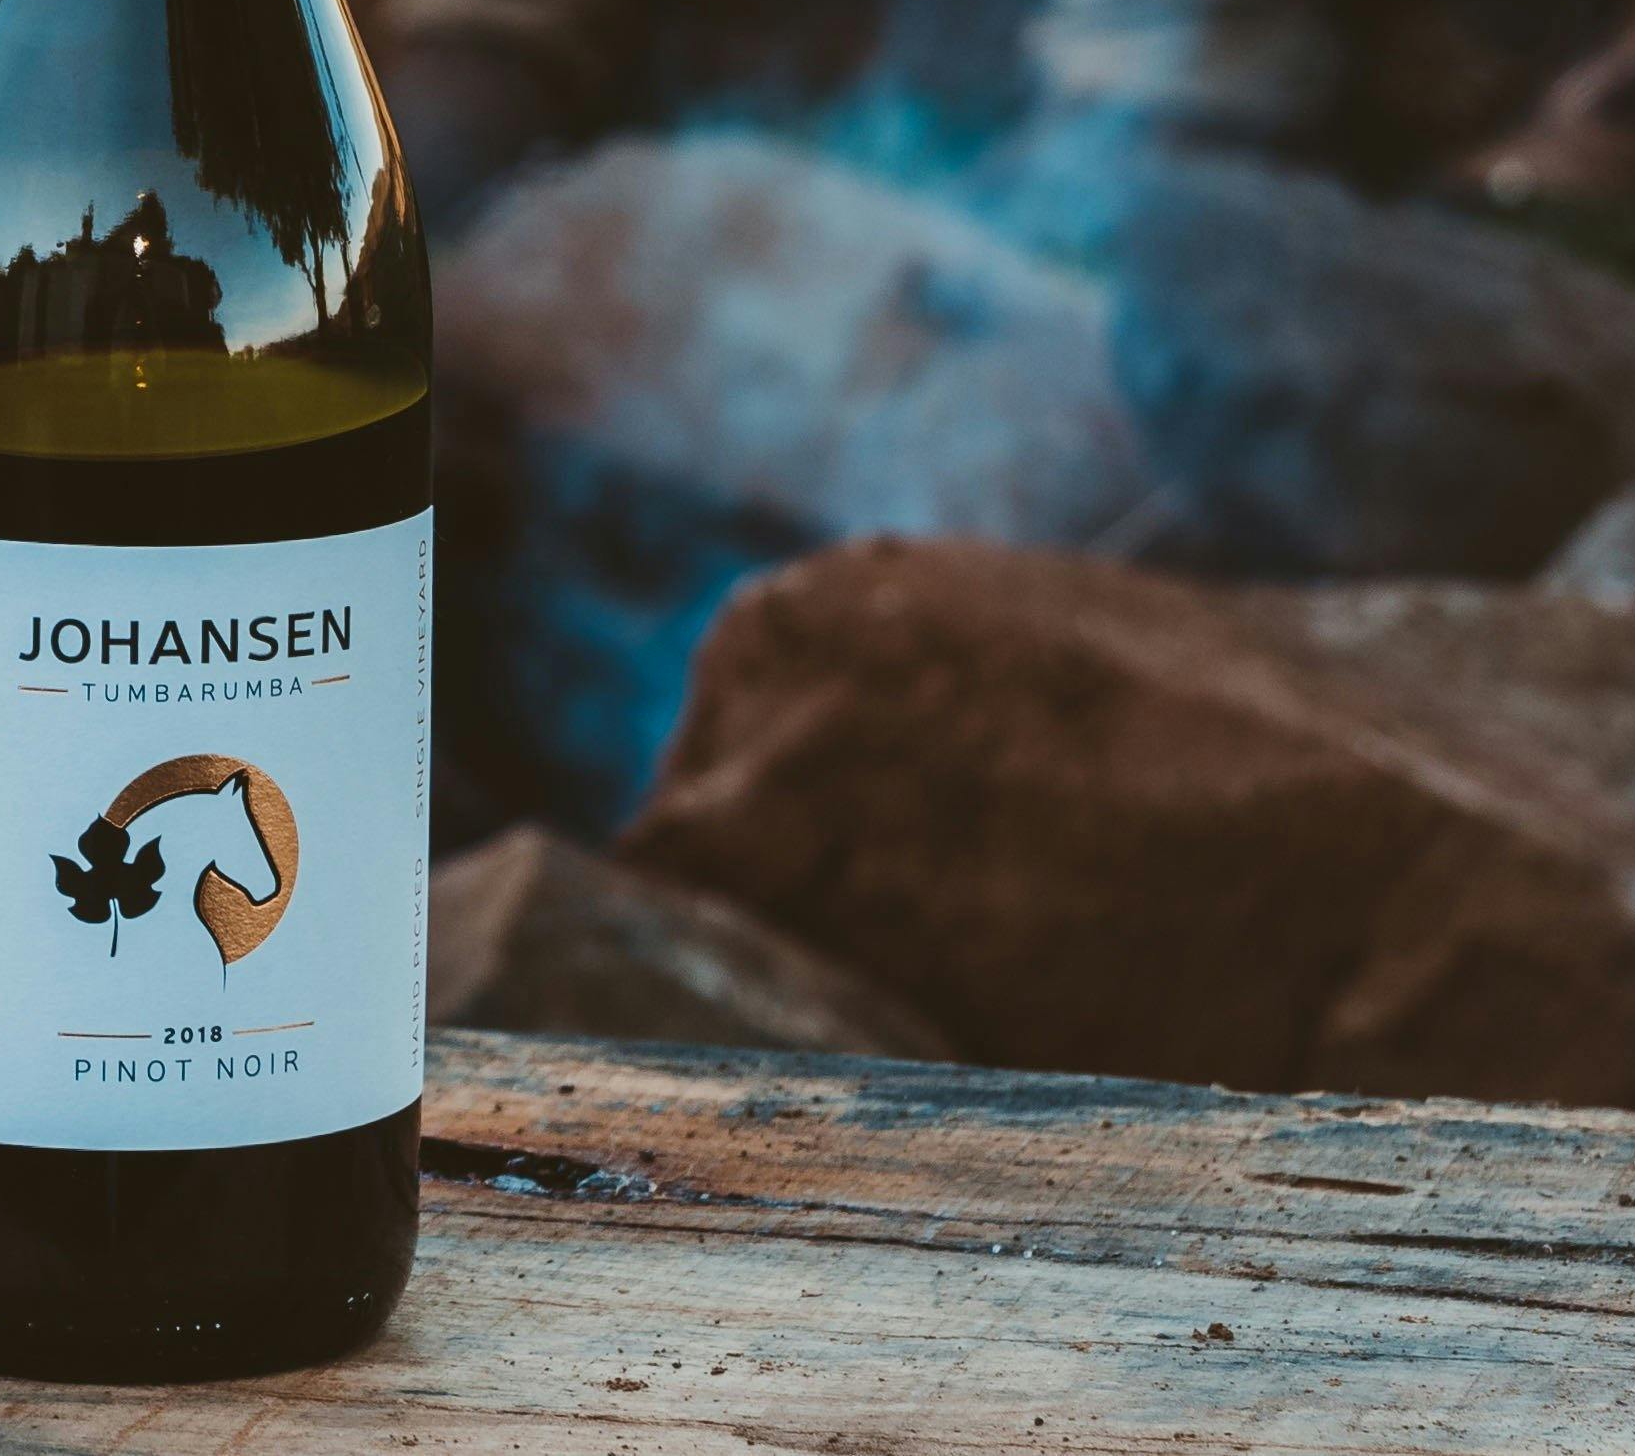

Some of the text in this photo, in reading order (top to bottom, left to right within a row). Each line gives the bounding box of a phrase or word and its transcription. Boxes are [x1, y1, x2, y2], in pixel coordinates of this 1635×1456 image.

[18, 605, 352, 665] JOHANSEN
[82, 676, 304, 703] TUMBARUMBA
[410, 539, 427, 1070] HAND PICKED SINGLE VINEYARD
[162, 1025, 223, 1045] 2018
[74, 1050, 300, 1083] PINOT NOIR
